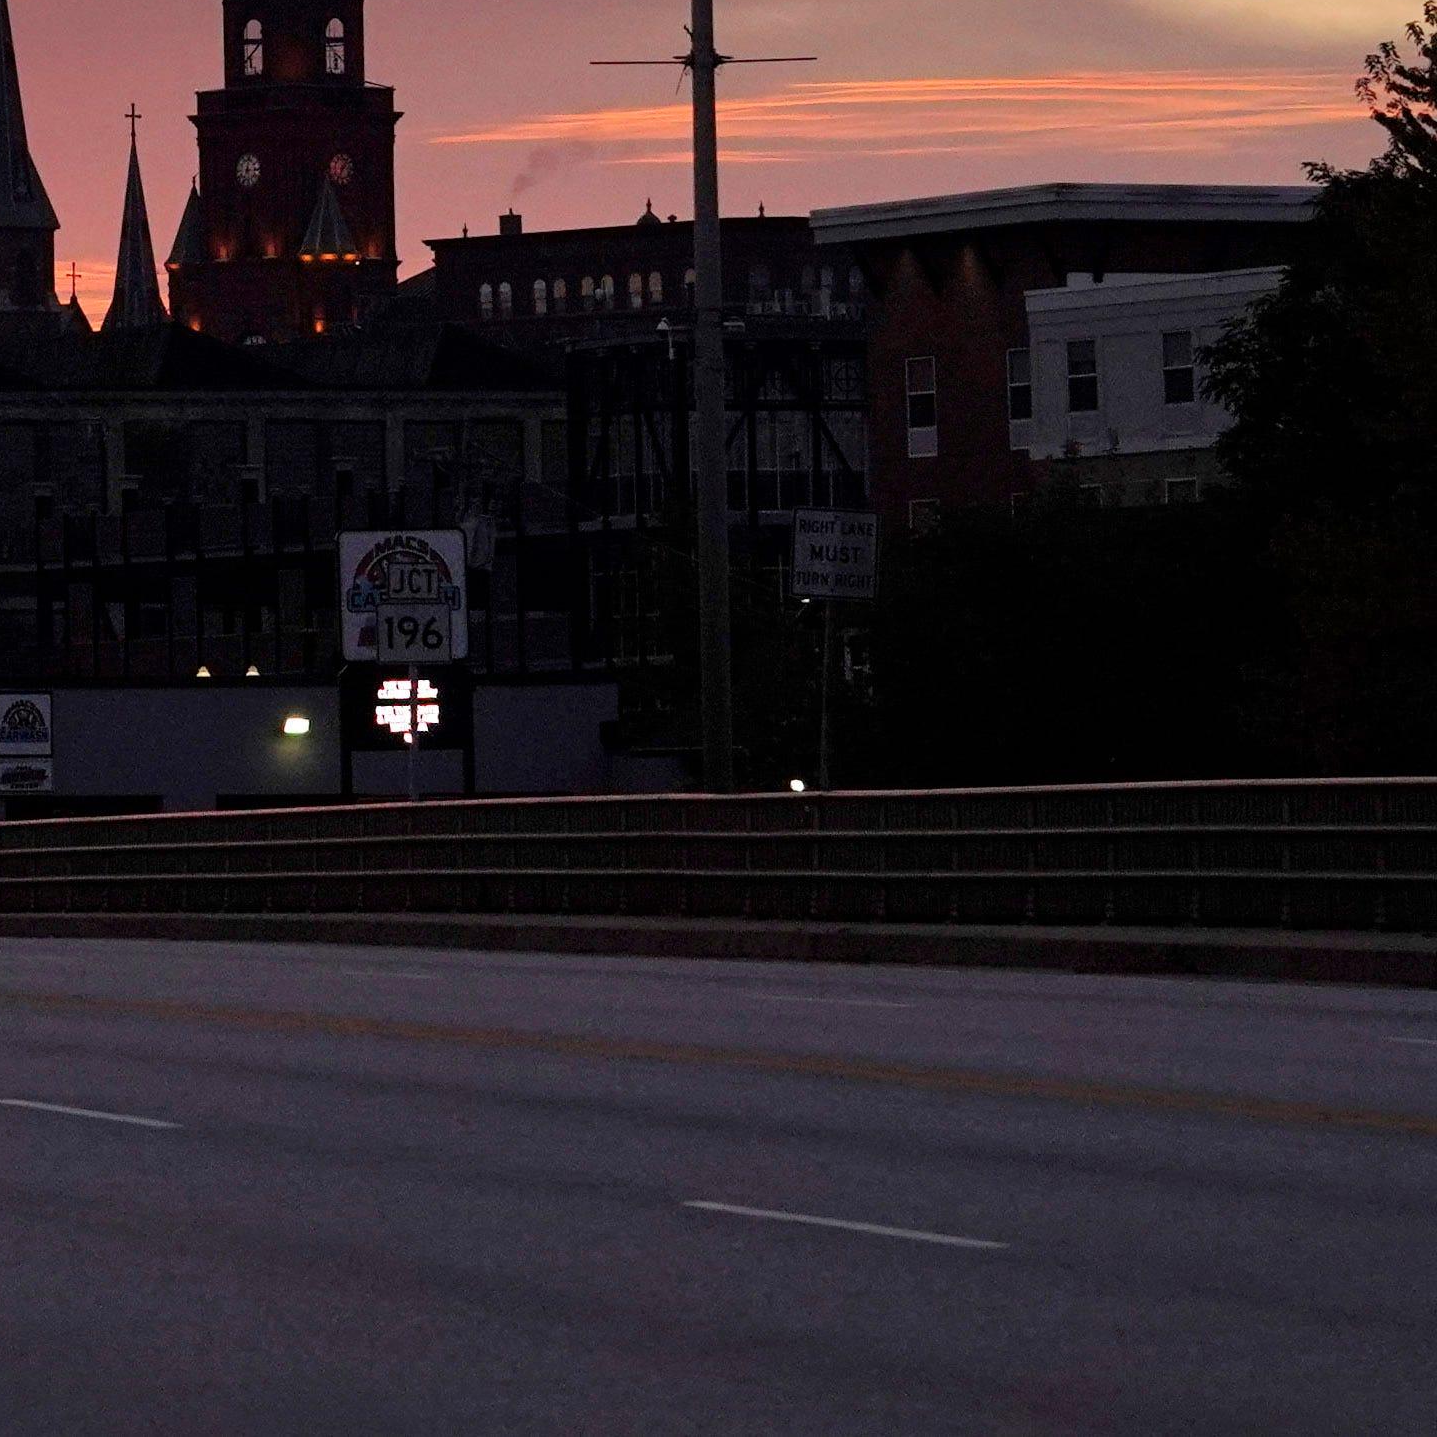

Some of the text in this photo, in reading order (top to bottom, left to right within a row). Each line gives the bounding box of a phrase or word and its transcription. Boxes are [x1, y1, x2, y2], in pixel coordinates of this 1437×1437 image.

[799, 519, 874, 537] RIGHT LANE
[374, 535, 429, 555] MACS
[810, 544, 861, 563] MUST
[392, 569, 435, 593] JCT
[796, 571, 872, 589] TURN RIGHT
[385, 616, 443, 649] 196
